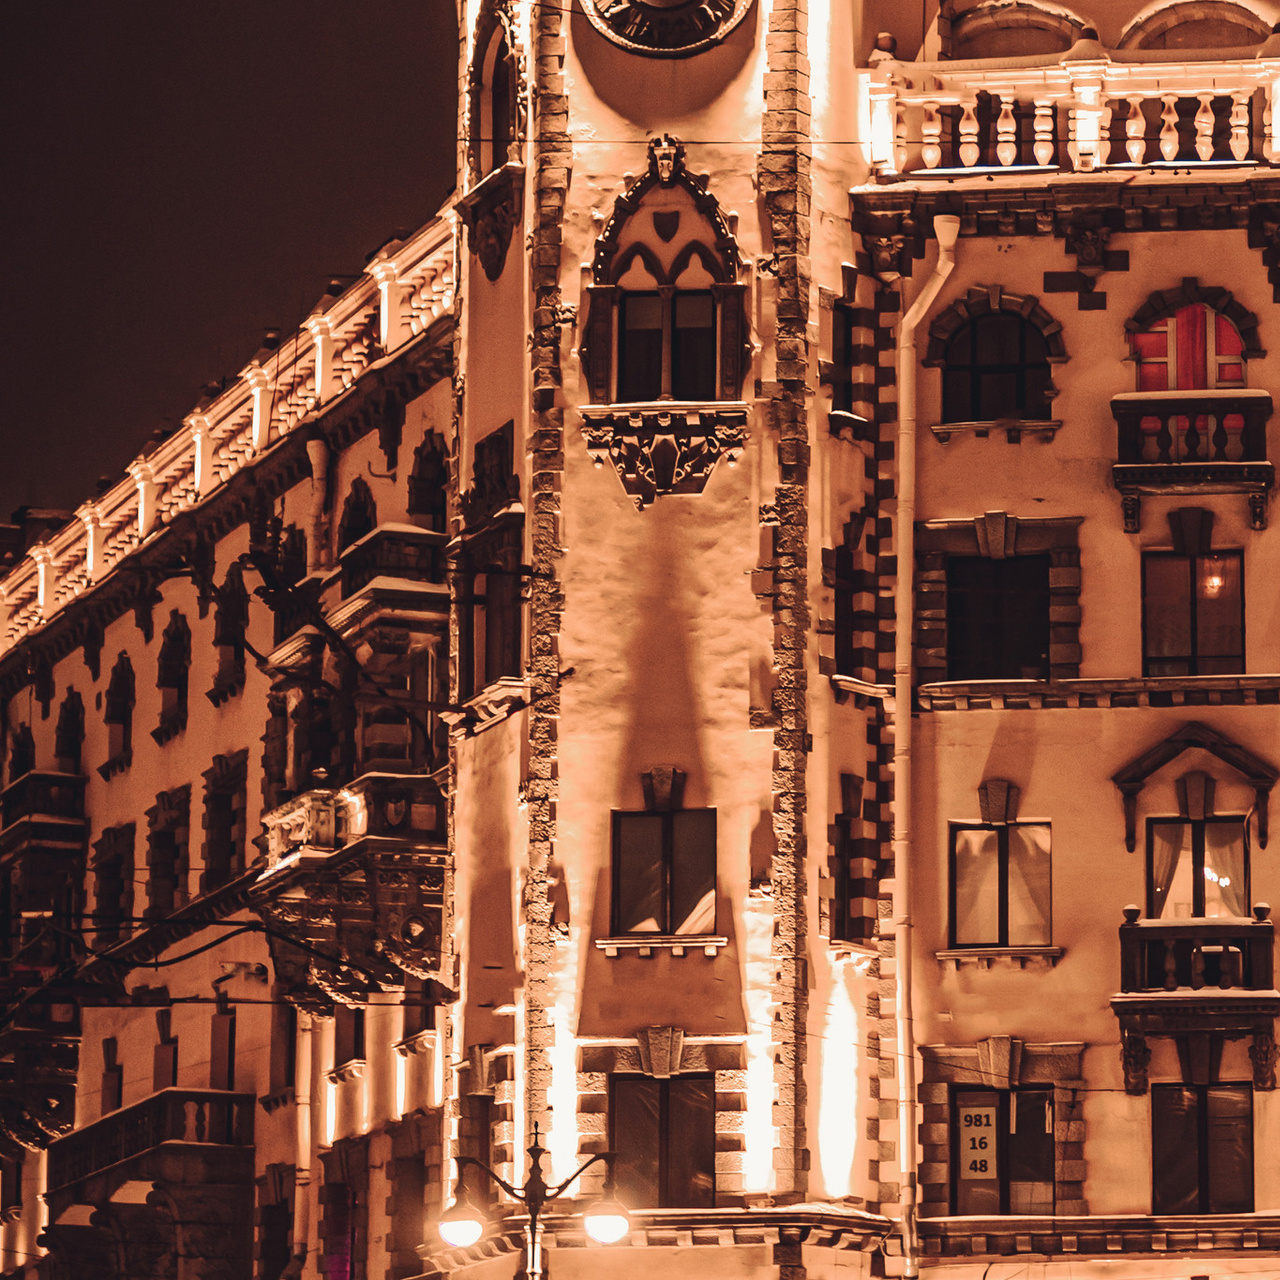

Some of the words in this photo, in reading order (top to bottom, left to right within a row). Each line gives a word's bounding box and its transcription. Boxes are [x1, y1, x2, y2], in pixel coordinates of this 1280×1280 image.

[963, 1113, 992, 1128] 981
[969, 1136, 989, 1150] 16
[968, 1159, 989, 1173] 48
